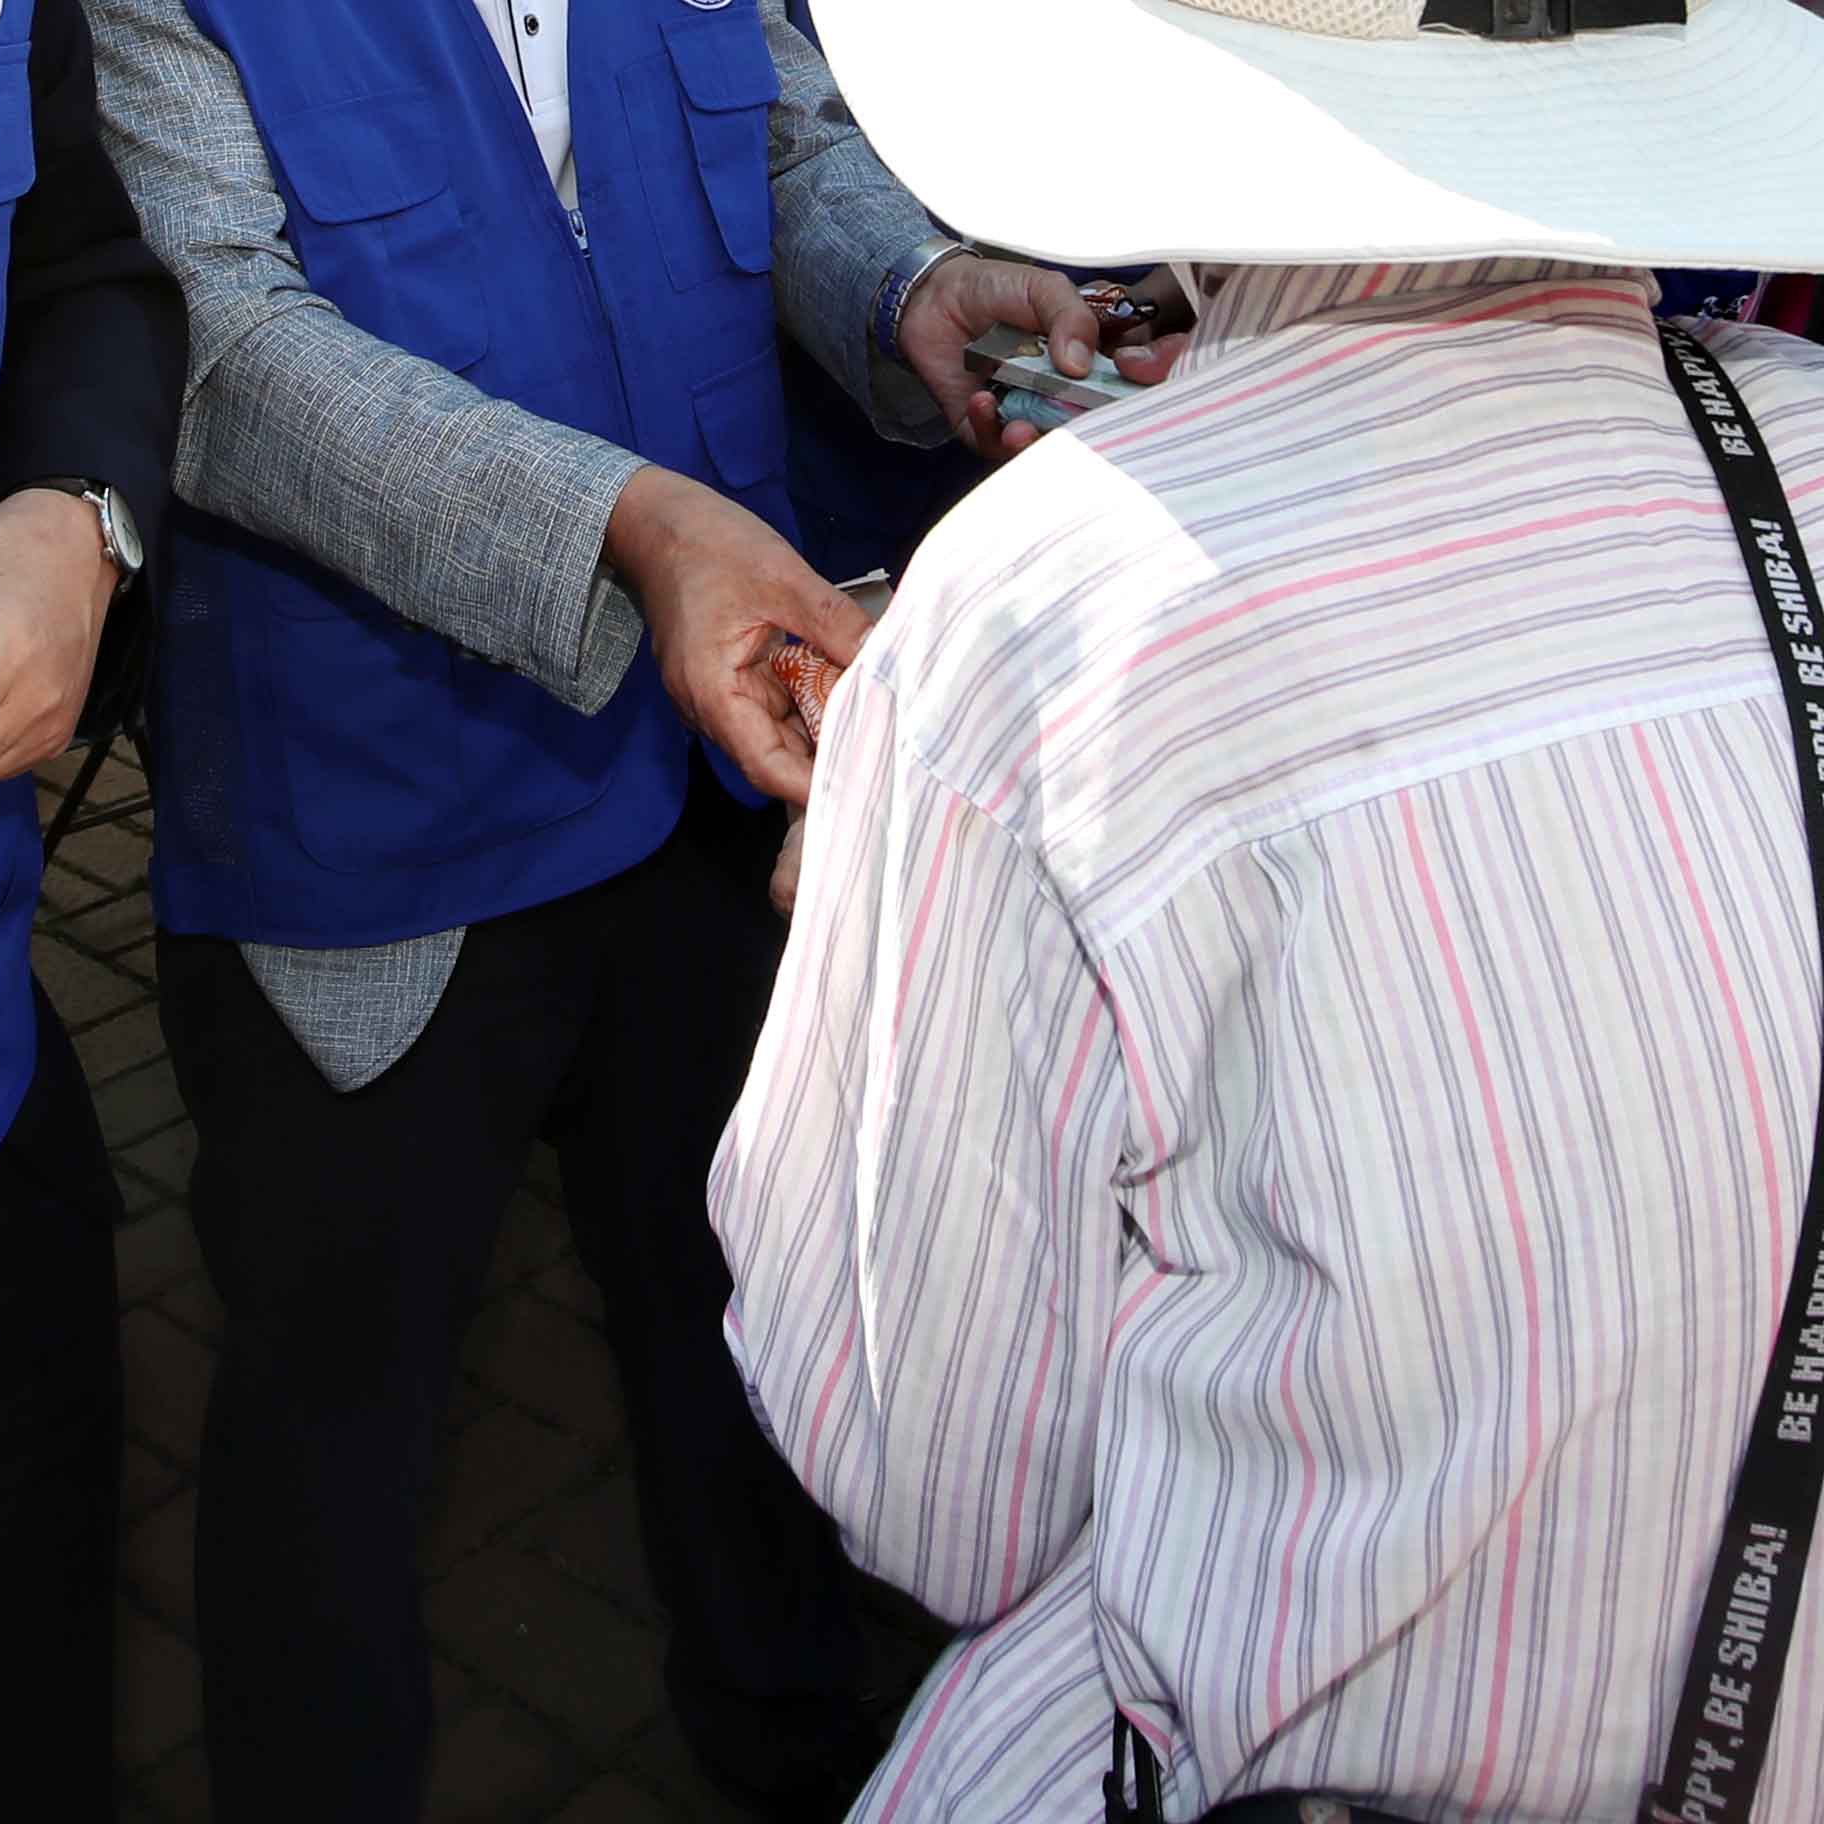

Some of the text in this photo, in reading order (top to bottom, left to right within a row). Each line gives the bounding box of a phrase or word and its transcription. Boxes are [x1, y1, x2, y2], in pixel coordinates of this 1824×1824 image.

[1711, 420, 1755, 458] BE
[1750, 518, 1815, 638] SHIBA!
[1777, 1391, 1819, 1443] BE
[1718, 1522, 1789, 1671] SHIBA!
[1703, 1673, 1753, 1730] BE
